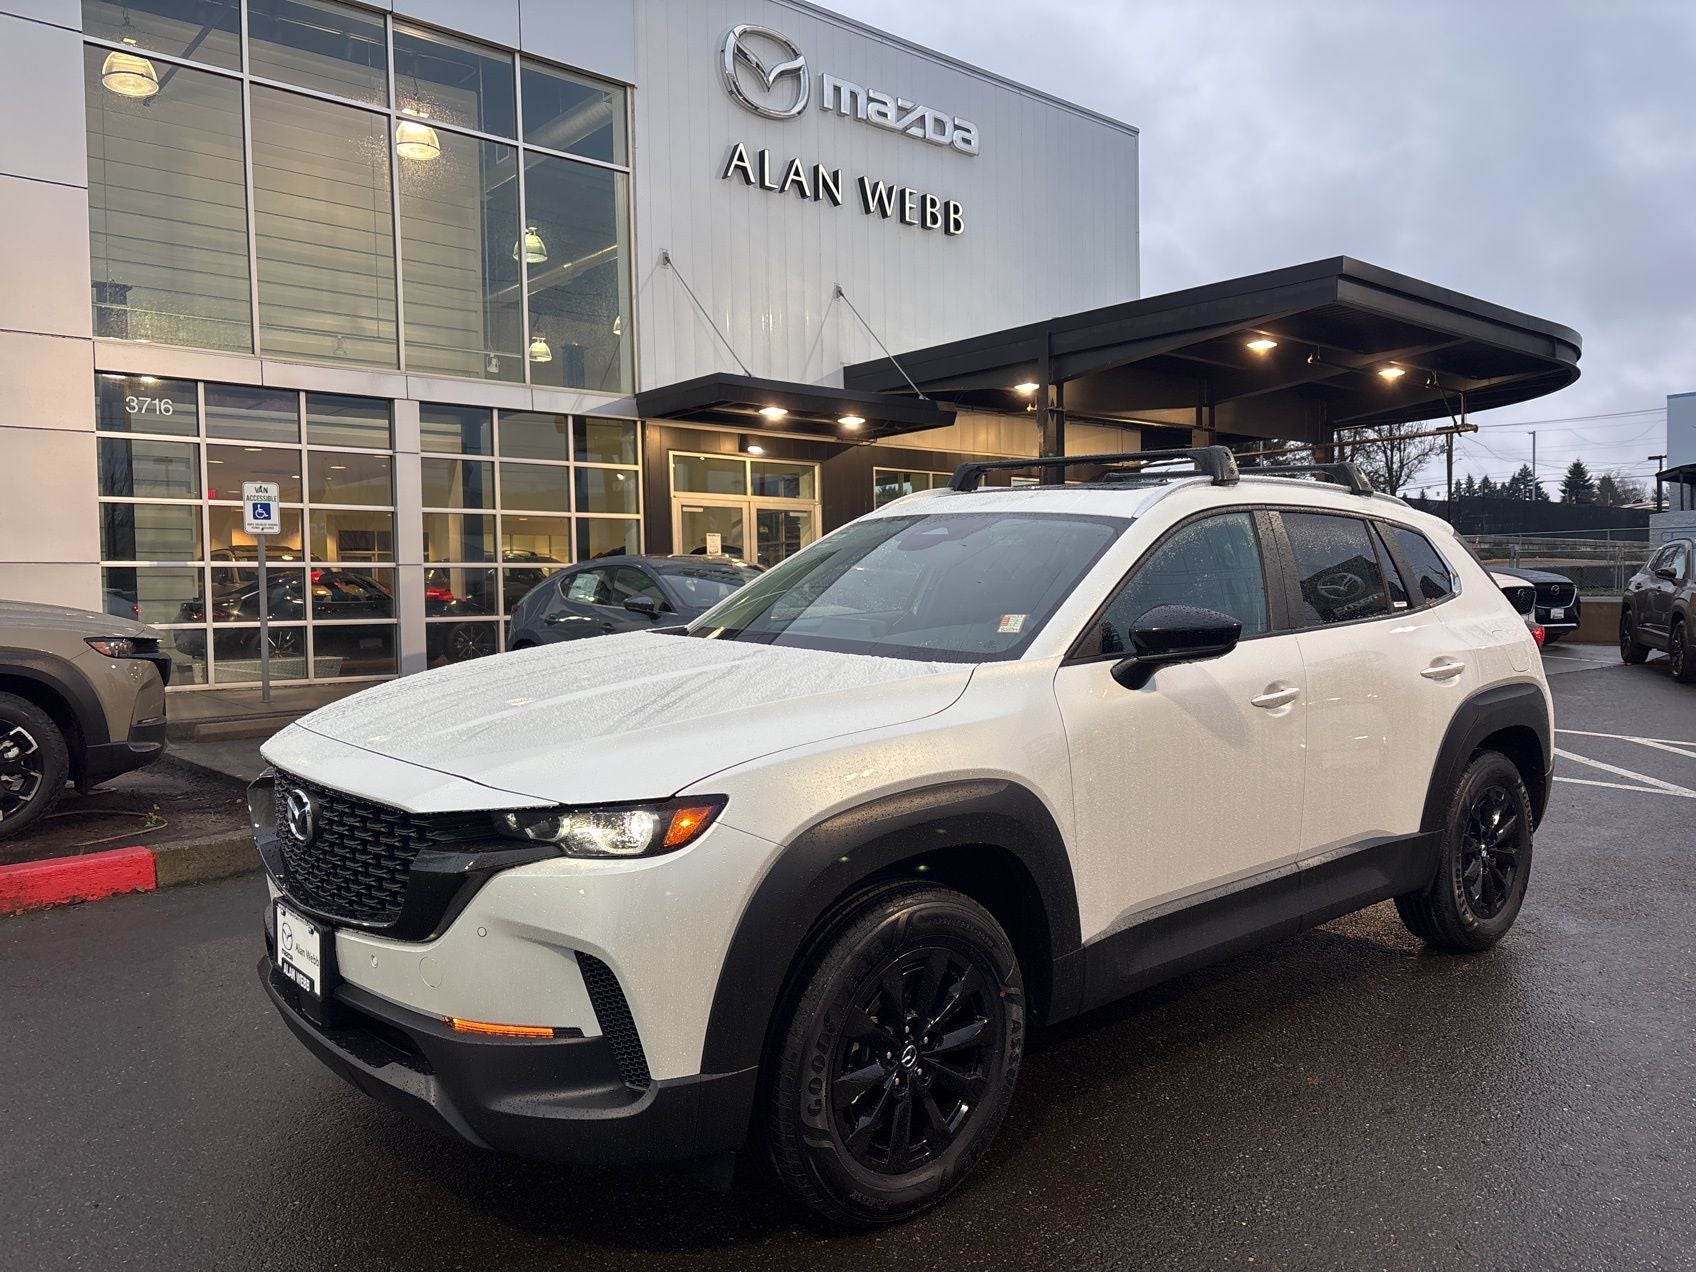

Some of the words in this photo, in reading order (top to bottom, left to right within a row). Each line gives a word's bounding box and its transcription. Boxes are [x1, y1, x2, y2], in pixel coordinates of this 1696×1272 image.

[722, 142, 842, 207] ALAN
[858, 176, 965, 236] WEBB
[125, 396, 173, 415] 3716
[283, 962, 296, 981] ALAN
[296, 970, 310, 992] WEBB
